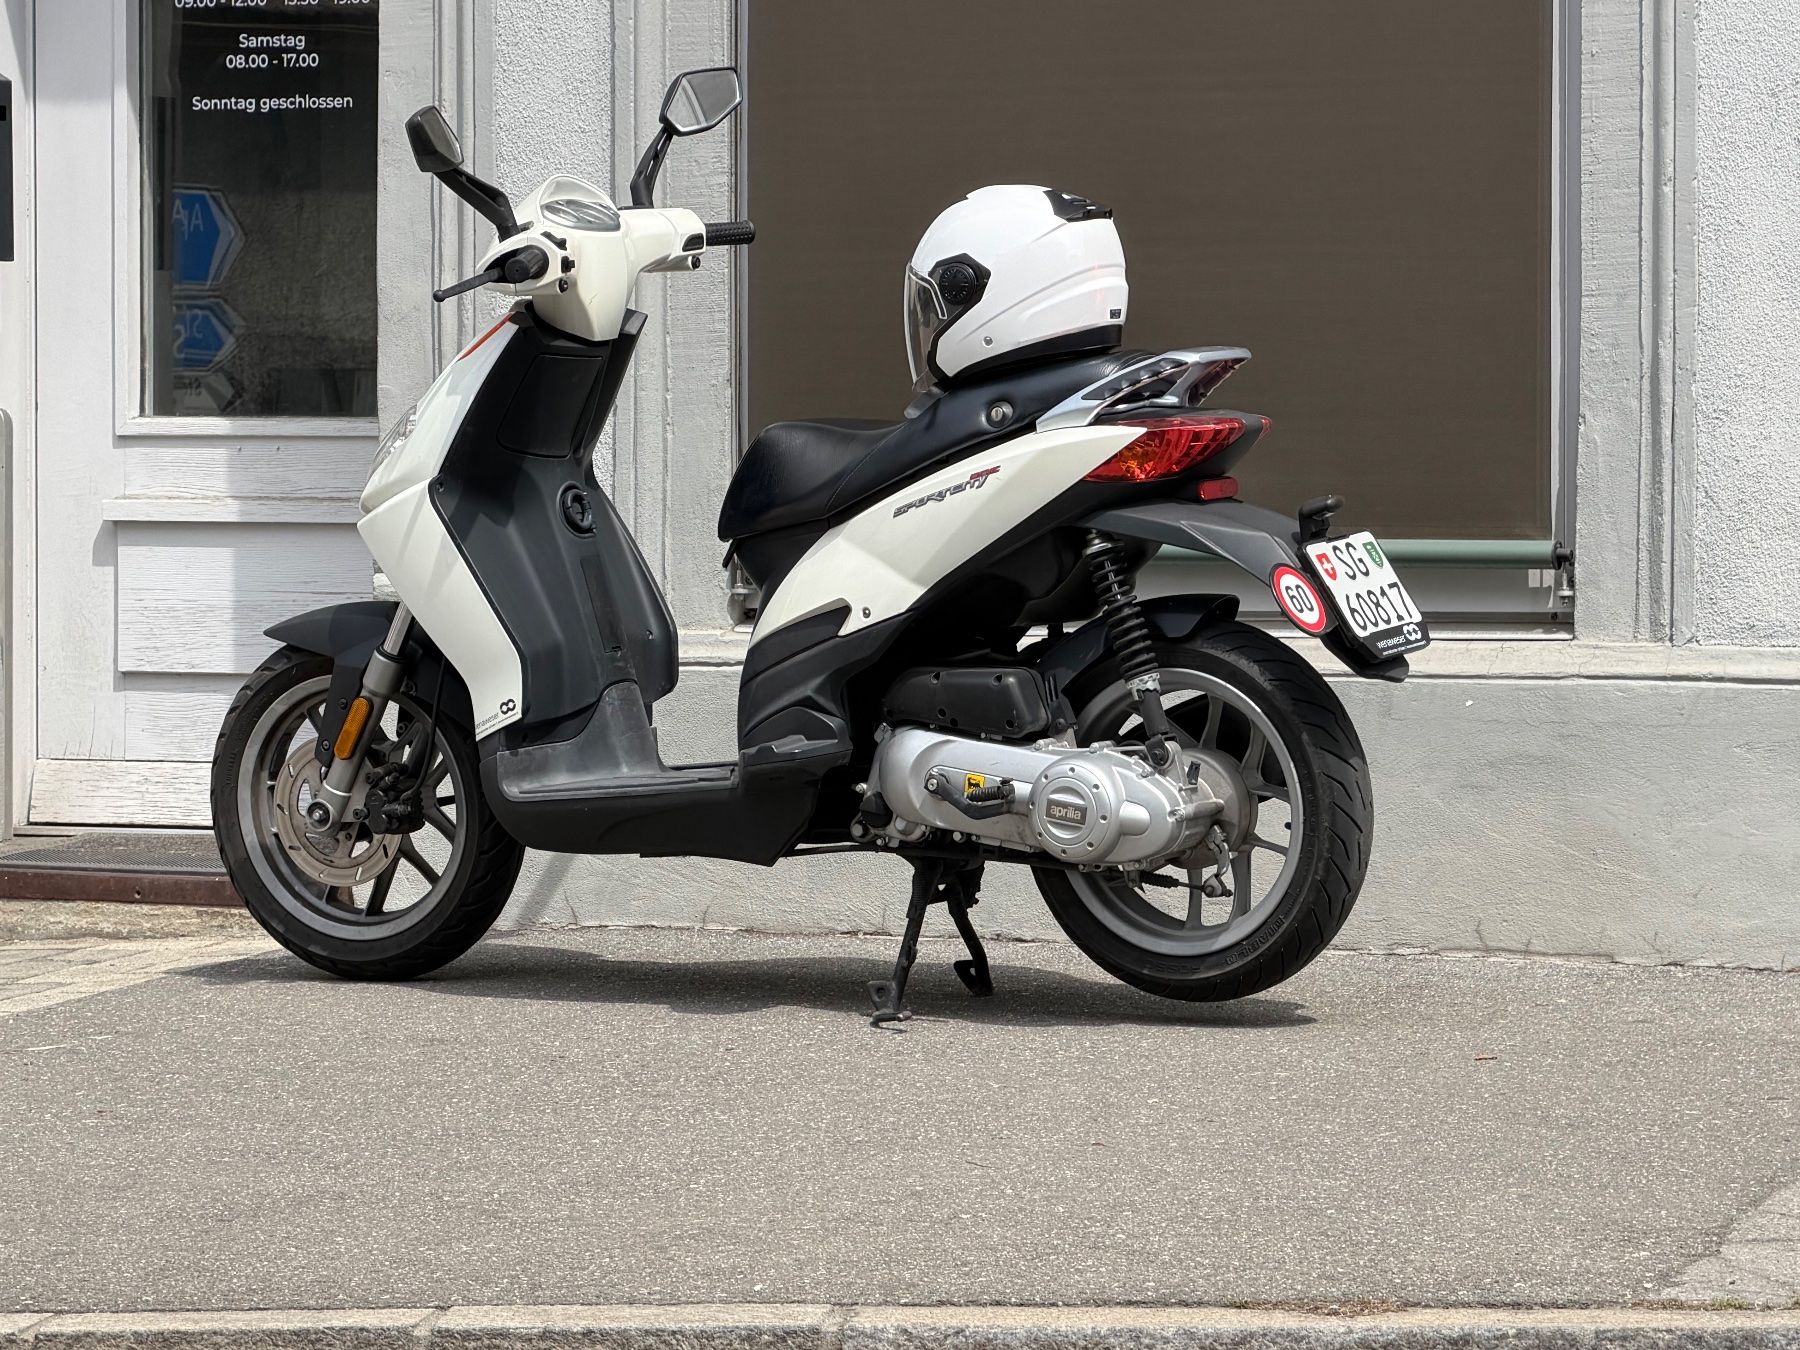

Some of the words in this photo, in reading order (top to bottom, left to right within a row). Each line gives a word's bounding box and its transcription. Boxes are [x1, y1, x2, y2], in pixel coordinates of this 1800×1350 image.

[239, 34, 306, 49] Samstag
[226, 54, 268, 68] 08.00
[282, 54, 319, 67] 17.00
[192, 96, 256, 112] Sonntag
[260, 94, 353, 112] geschlossen
[1332, 542, 1369, 580] SG
[1285, 584, 1314, 613] 60
[1346, 582, 1412, 631] 60817
[1050, 805, 1082, 820] aprilia
